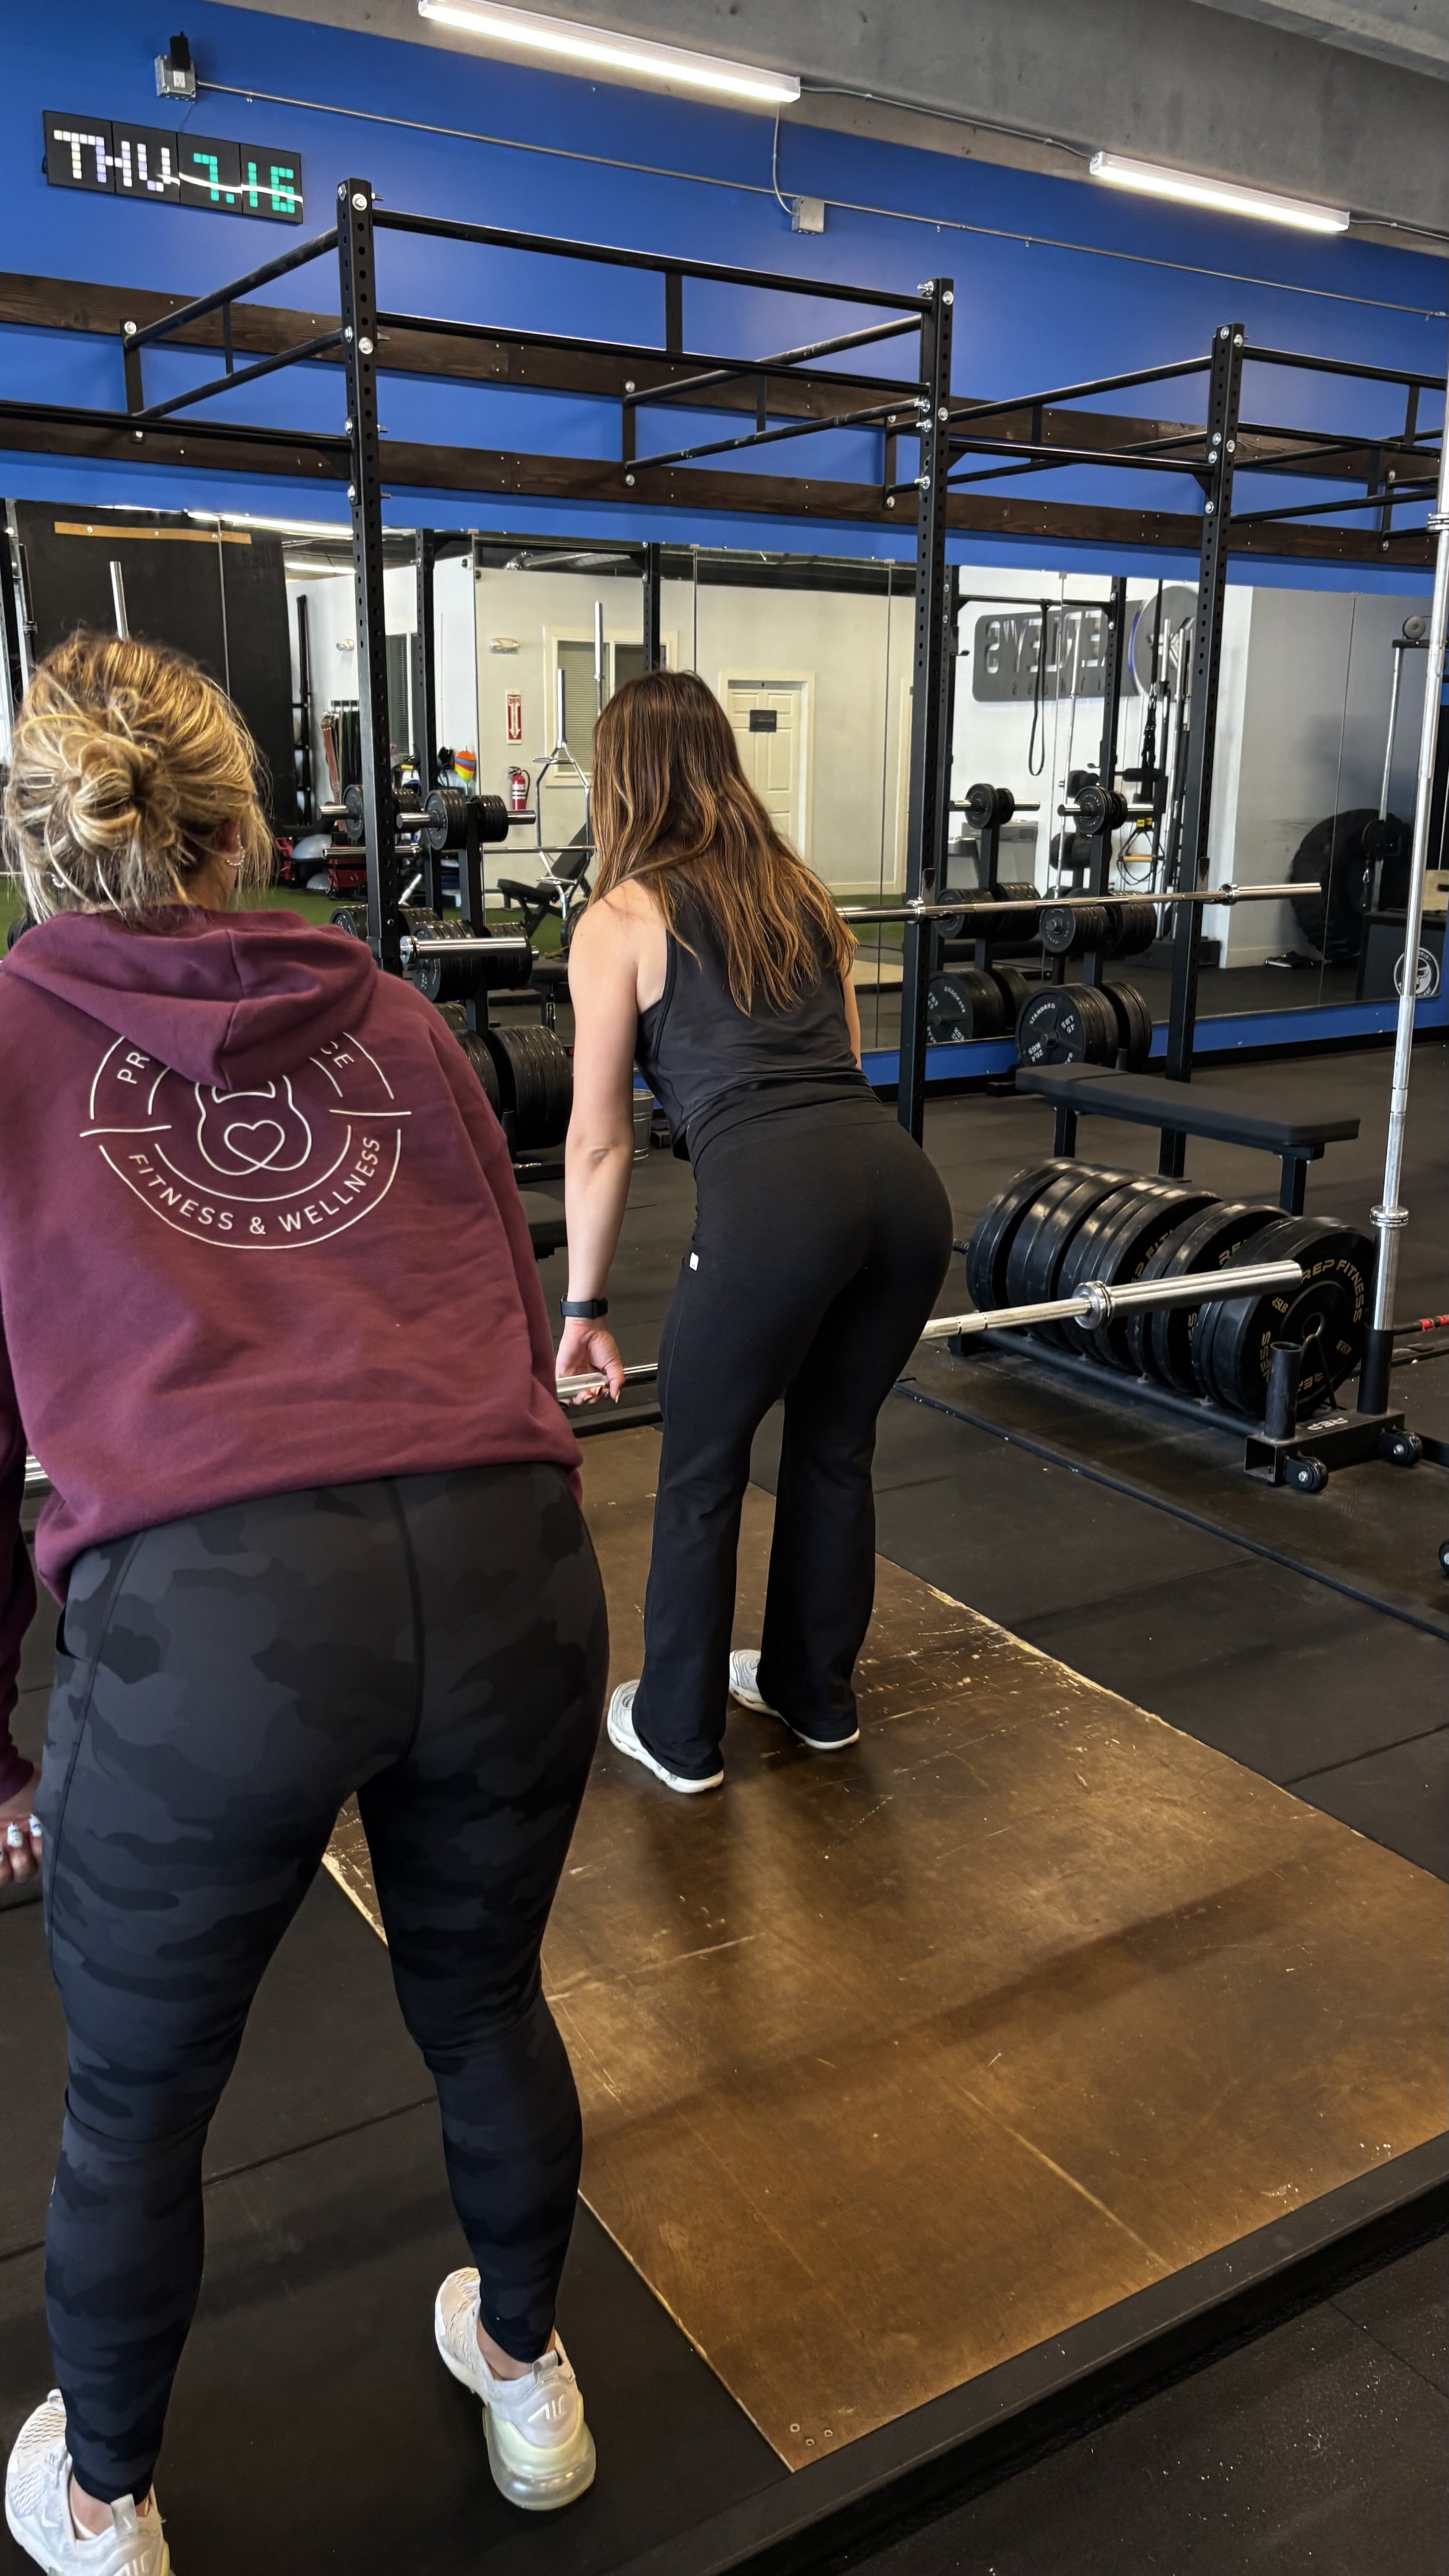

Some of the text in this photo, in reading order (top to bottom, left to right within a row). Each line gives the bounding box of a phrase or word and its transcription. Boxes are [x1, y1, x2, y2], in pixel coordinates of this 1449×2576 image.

[54, 130, 295, 213] THU 7.16
[1029, 1003, 1055, 1025] STANDARD
[1061, 1014, 1073, 1028] LBS
[1028, 1042, 1041, 1056] KGS
[129, 1137, 380, 1235] FITNESS & WELLNESS
[1301, 1258, 1364, 1323] REP FITNESS
[1272, 1297, 1288, 1314] 45LB
[1336, 1340, 1352, 1355] 45LB
[1307, 1417, 1348, 1430] REP
